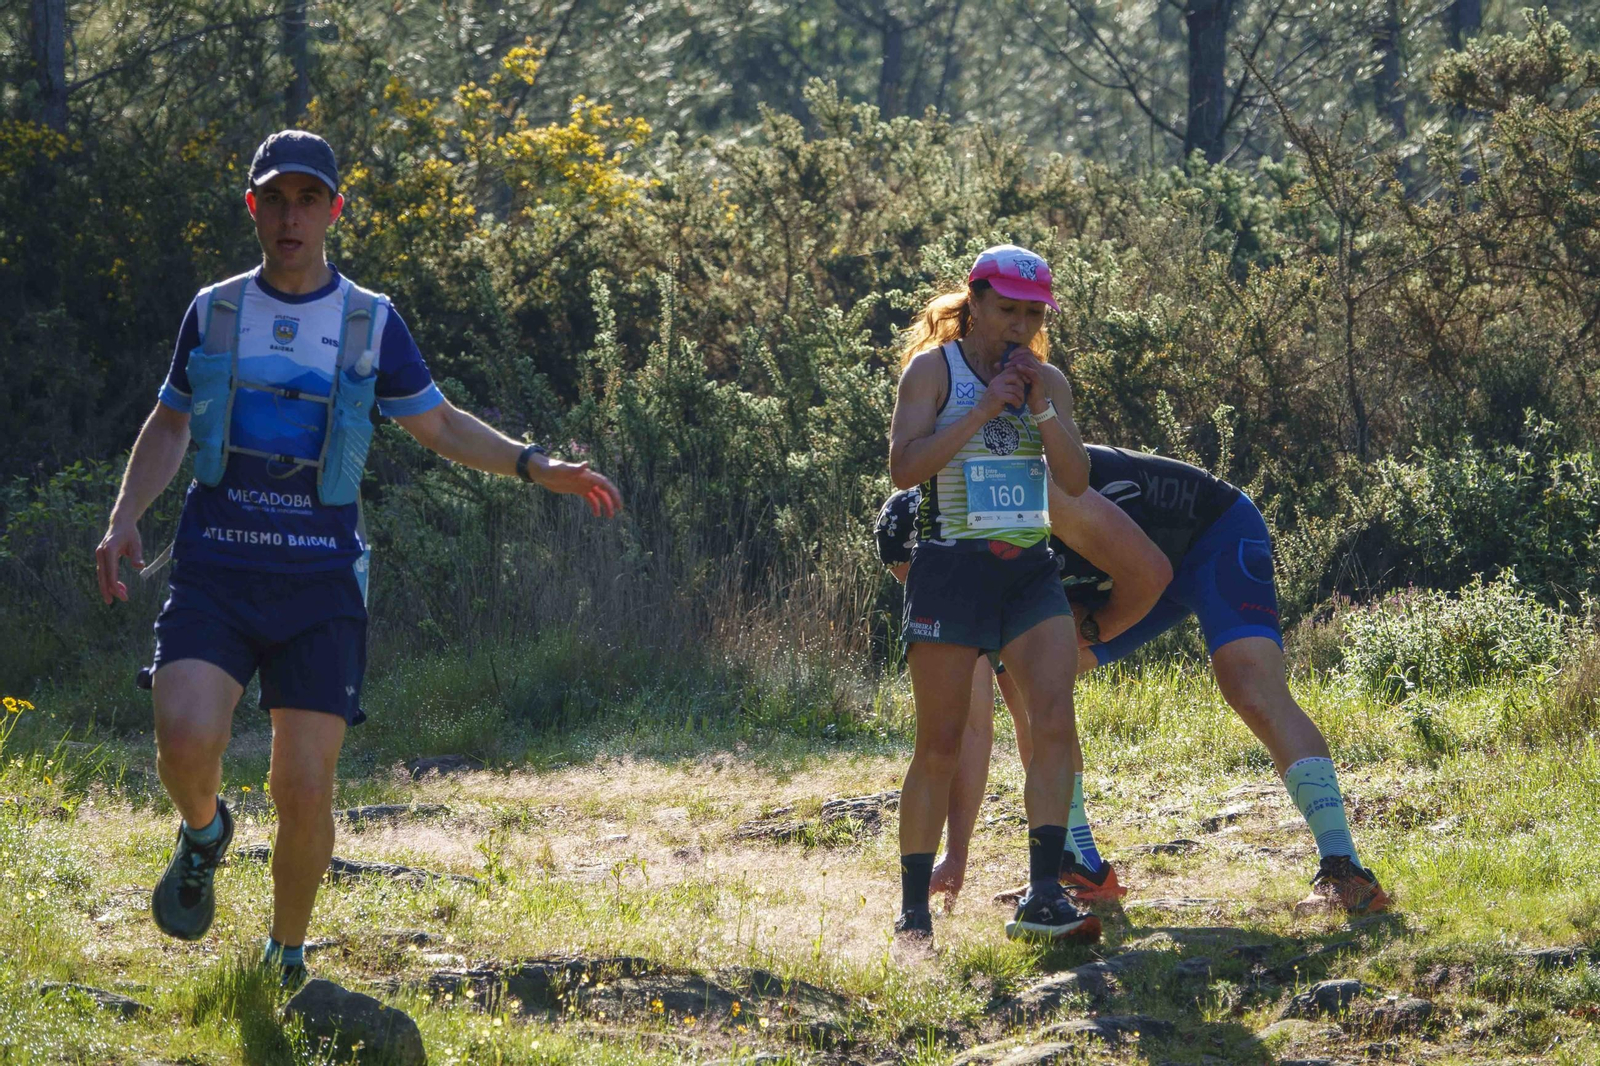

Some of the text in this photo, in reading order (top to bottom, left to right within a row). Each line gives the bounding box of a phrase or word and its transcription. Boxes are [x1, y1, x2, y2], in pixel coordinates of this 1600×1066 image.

[227, 488, 312, 508] MECADOBA
[989, 485, 1025, 507] 160
[202, 527, 283, 546] ATLETISMO
